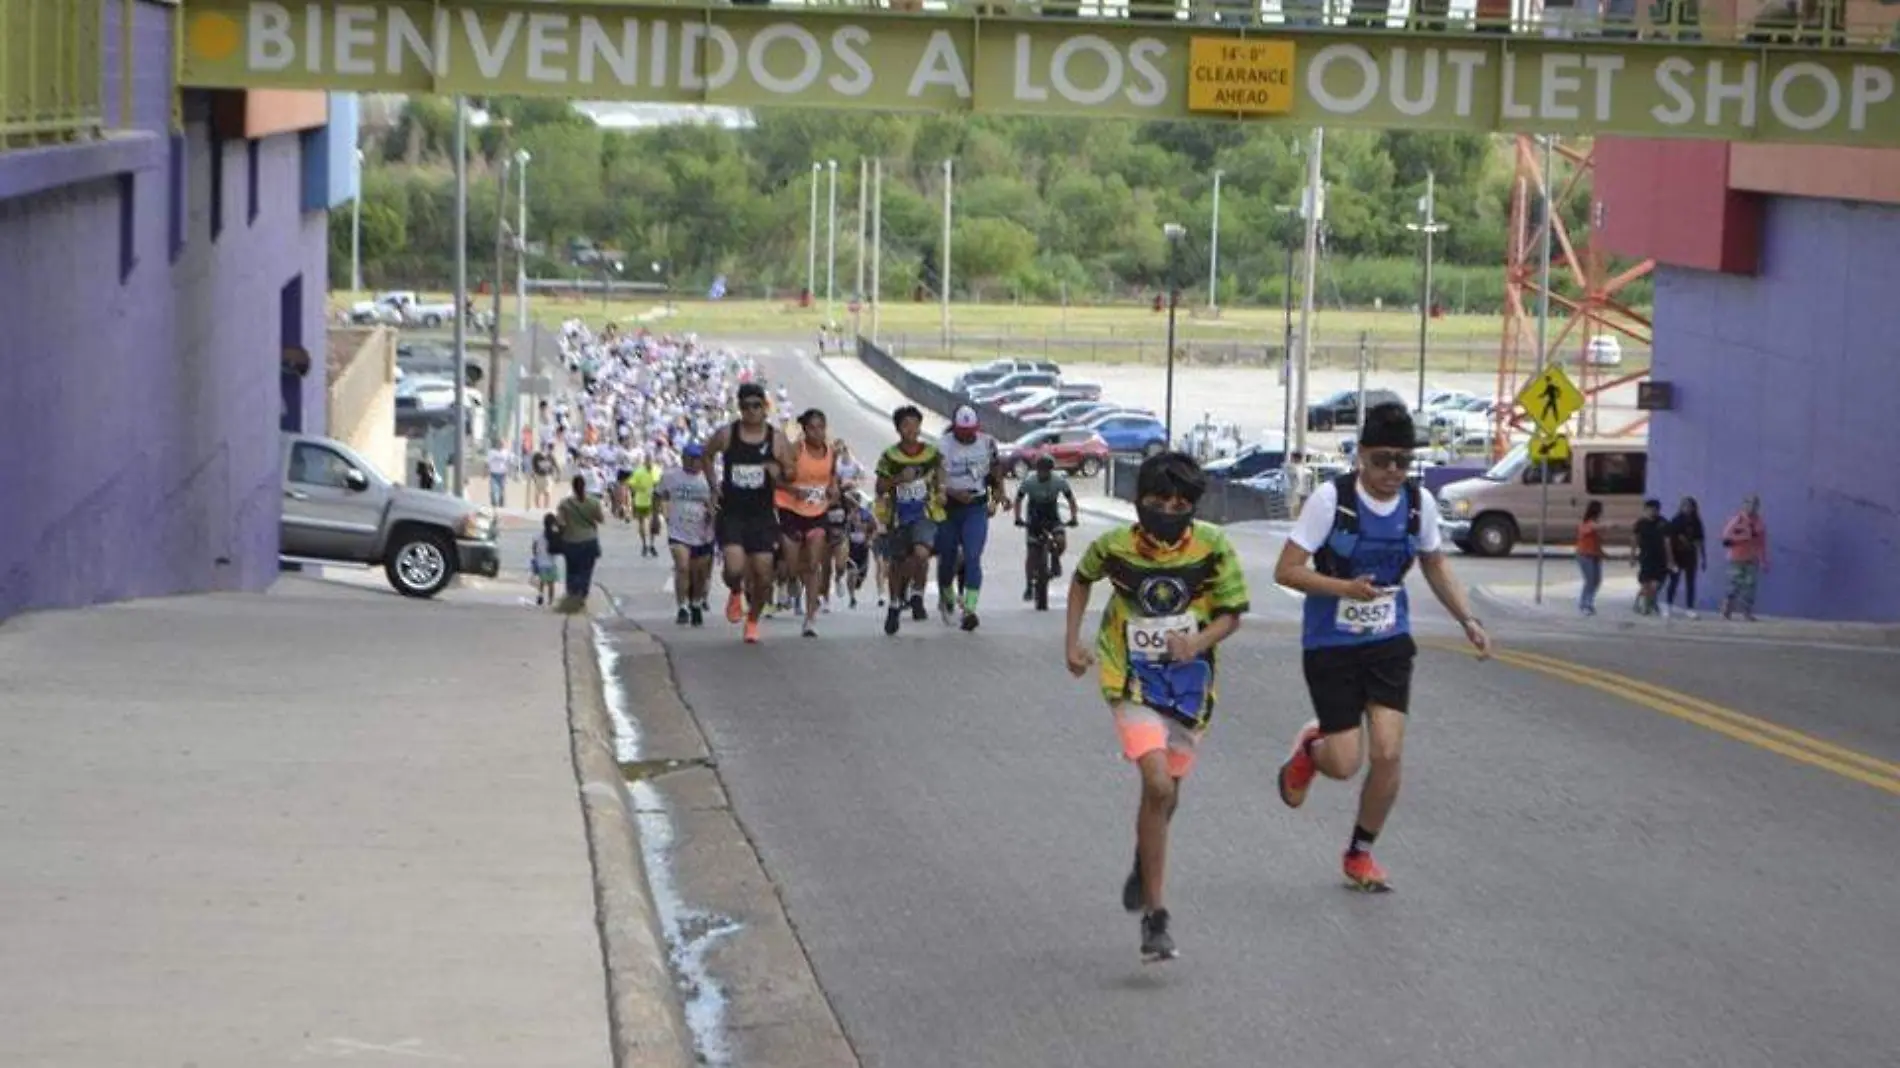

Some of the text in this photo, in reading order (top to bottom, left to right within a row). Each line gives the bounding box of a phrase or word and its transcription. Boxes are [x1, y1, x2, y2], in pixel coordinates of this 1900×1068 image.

[247, 1, 873, 96] BIENVENIDOS
[907, 30, 972, 98] A
[1014, 34, 1168, 107] LOS
[1651, 57, 1893, 130] SHOP
[1195, 66, 1288, 85] CLEARANCE
[1216, 89, 1268, 104] AHEAD
